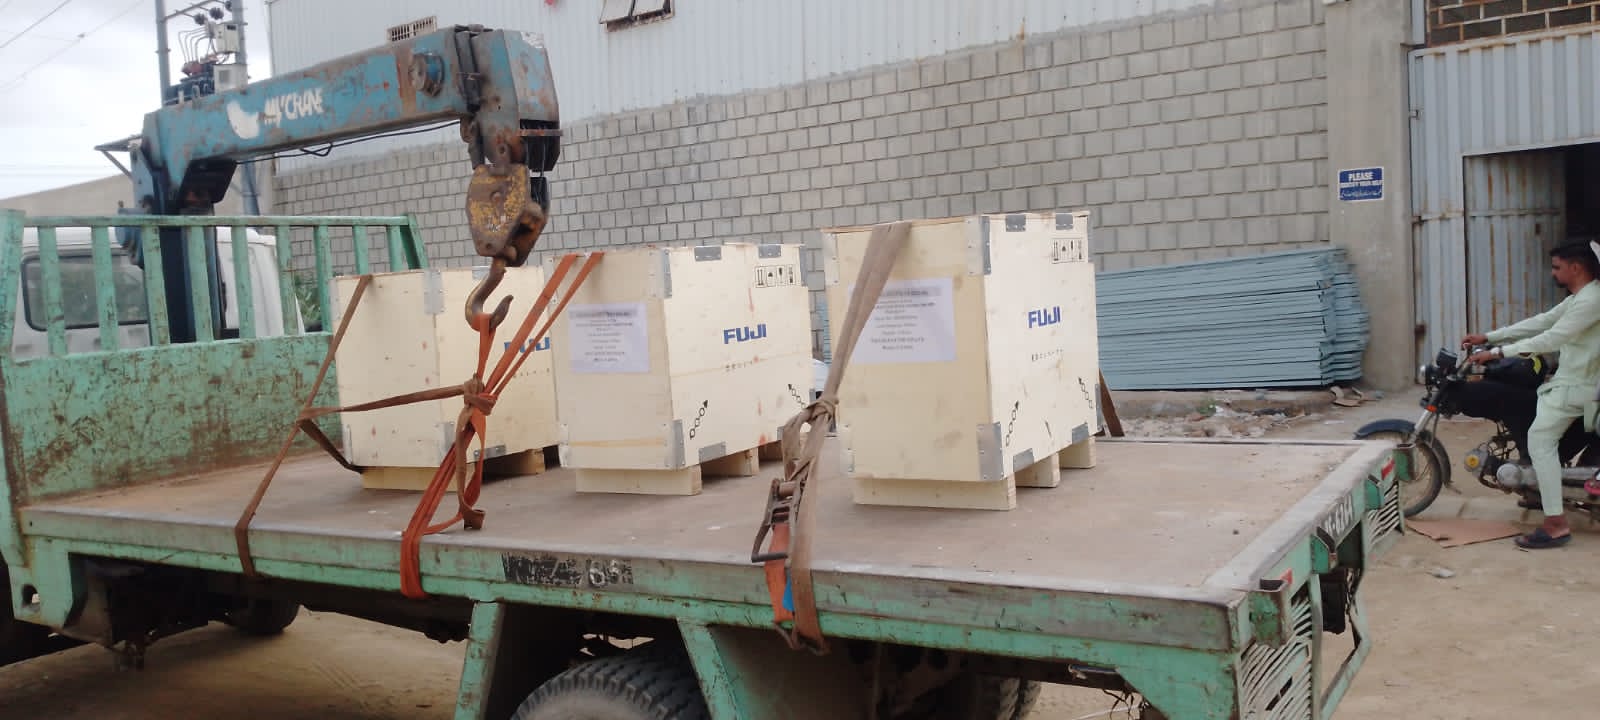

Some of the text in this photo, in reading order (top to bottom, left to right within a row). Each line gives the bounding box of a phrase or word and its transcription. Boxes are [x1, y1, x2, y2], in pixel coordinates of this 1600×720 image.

[1348, 171, 1374, 181] PLEASE
[1028, 306, 1061, 329] FUJI
[723, 323, 767, 344] FUJI
